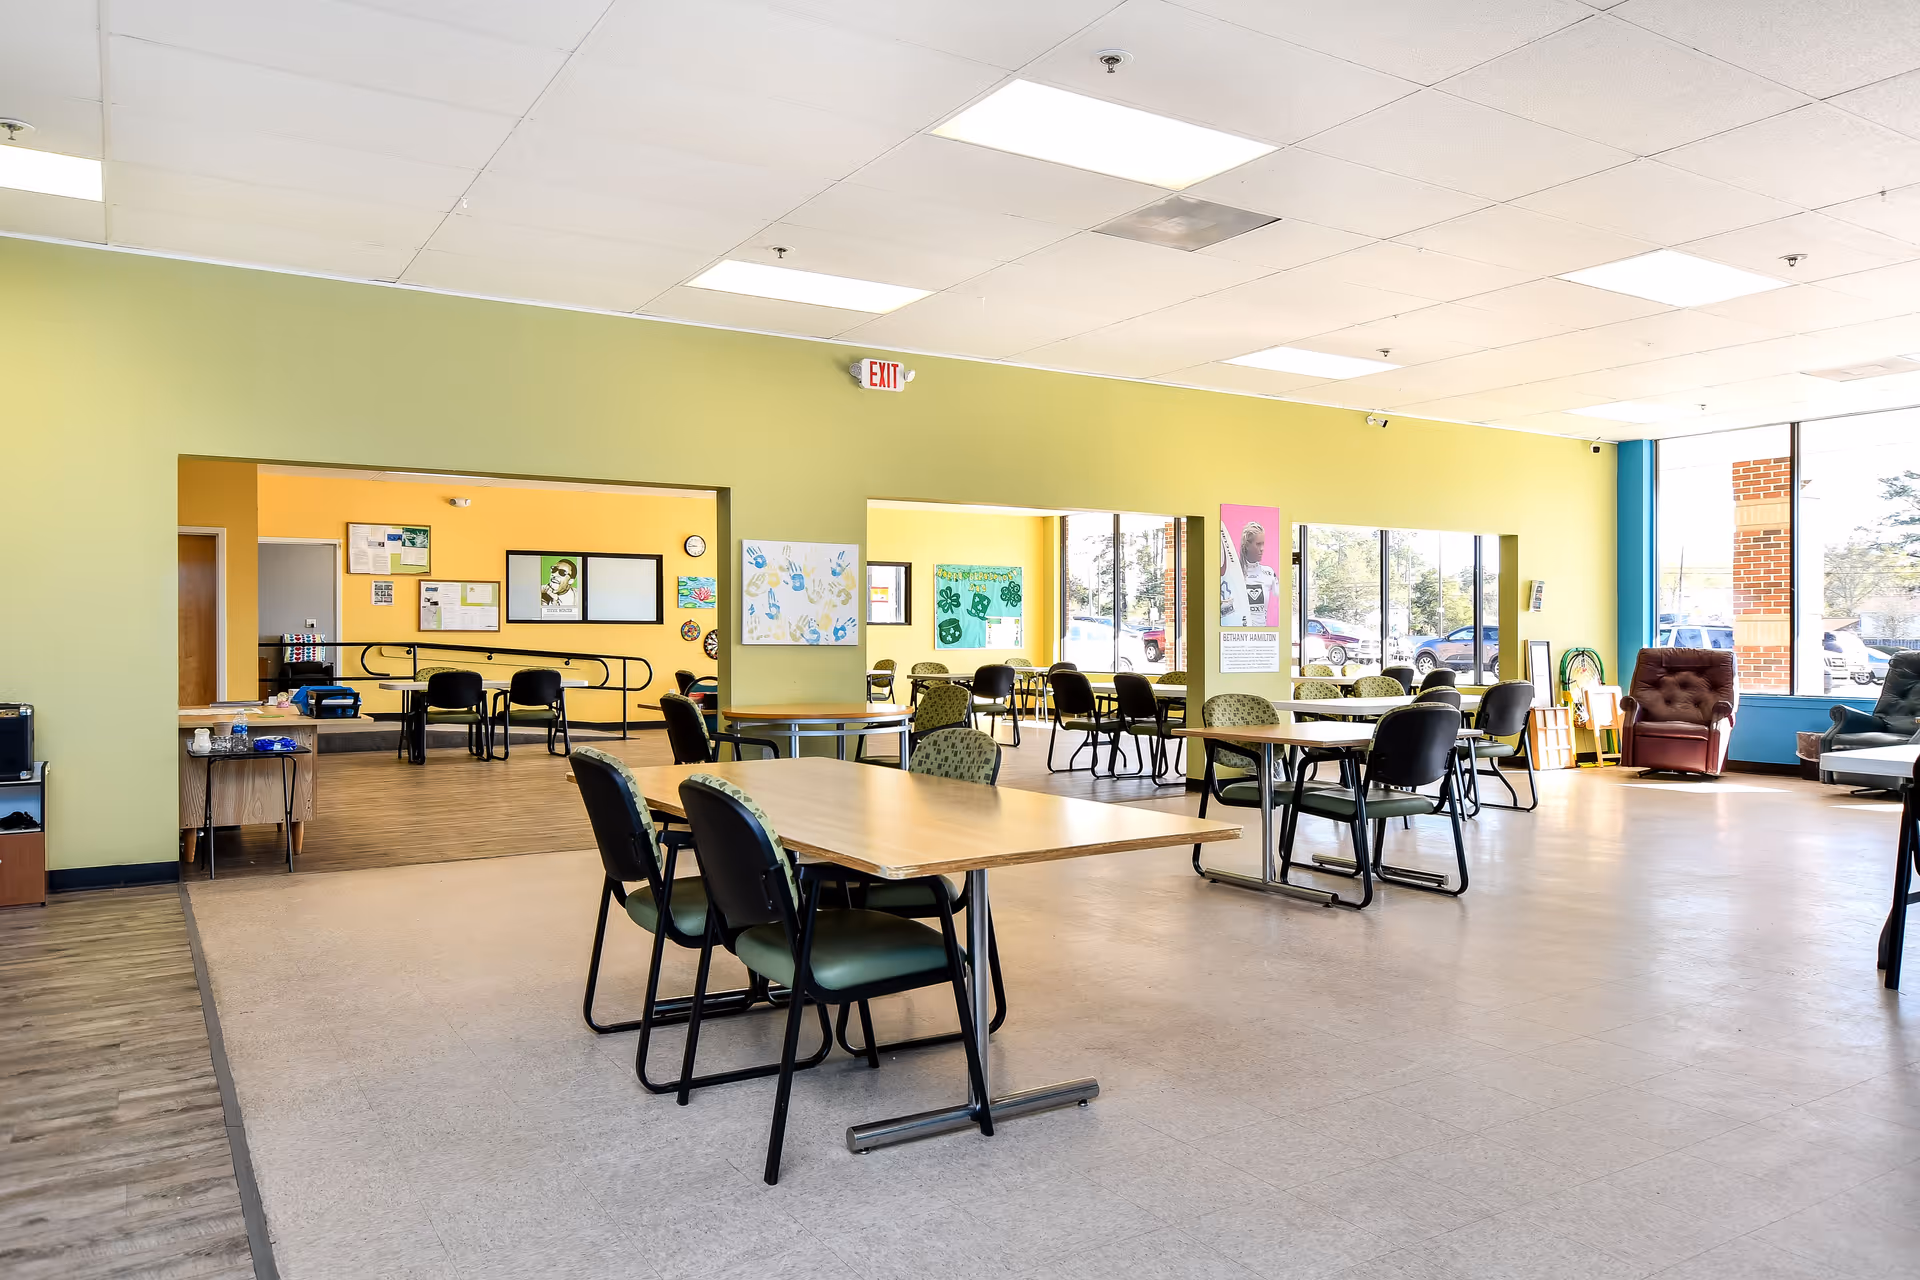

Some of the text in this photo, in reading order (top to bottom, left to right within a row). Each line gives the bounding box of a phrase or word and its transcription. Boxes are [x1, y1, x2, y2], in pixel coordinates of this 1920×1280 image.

[870, 361, 899, 388] EXIT
[1223, 633, 1276, 641] BETHANY HAMILTON
